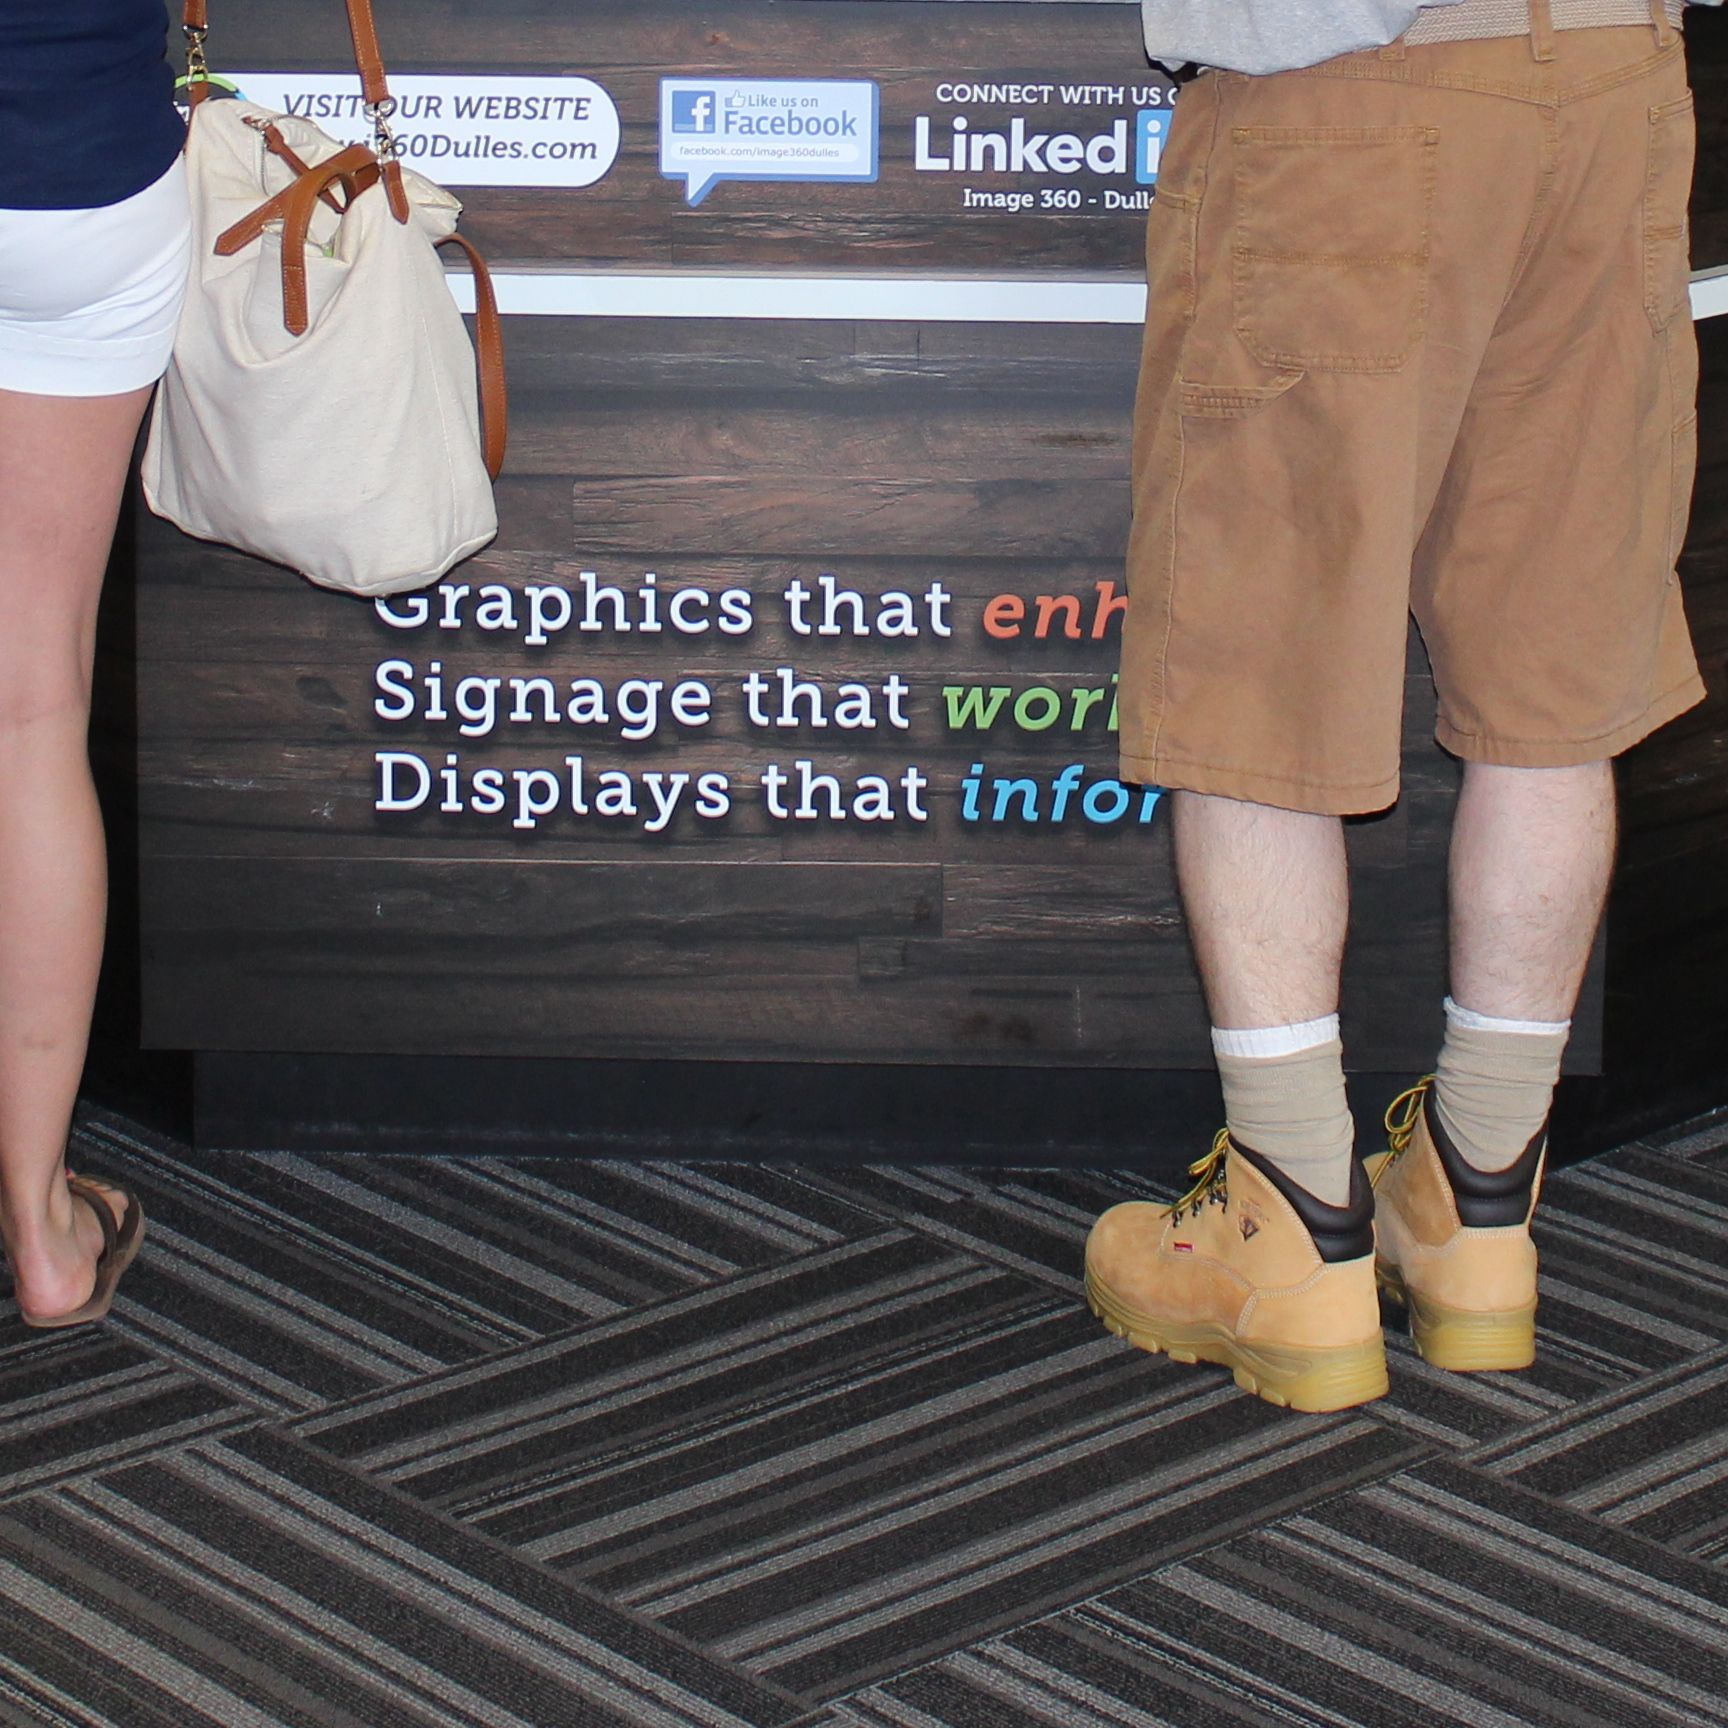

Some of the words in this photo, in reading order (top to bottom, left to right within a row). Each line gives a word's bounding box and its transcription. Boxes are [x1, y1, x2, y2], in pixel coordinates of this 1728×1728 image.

[748, 94, 778, 108] Like
[781, 97, 797, 108] us
[801, 98, 819, 108] on
[936, 83, 1054, 104] CONNECT
[1059, 85, 1124, 105] WITH
[1131, 86, 1162, 106] US
[453, 95, 592, 121] WEBSITE
[724, 110, 857, 136] Facebook
[963, 188, 1035, 213] Image
[1040, 189, 1082, 209] 360
[1104, 190, 1155, 210] Dull
[375, 572, 753, 646] Graphics
[785, 573, 952, 639] that
[982, 582, 1127, 640] enh
[375, 658, 712, 738] Signage
[742, 667, 910, 730] that
[942, 672, 1120, 732] wor
[375, 751, 731, 832] Displays
[761, 759, 928, 821] that
[960, 763, 1169, 825] infor
